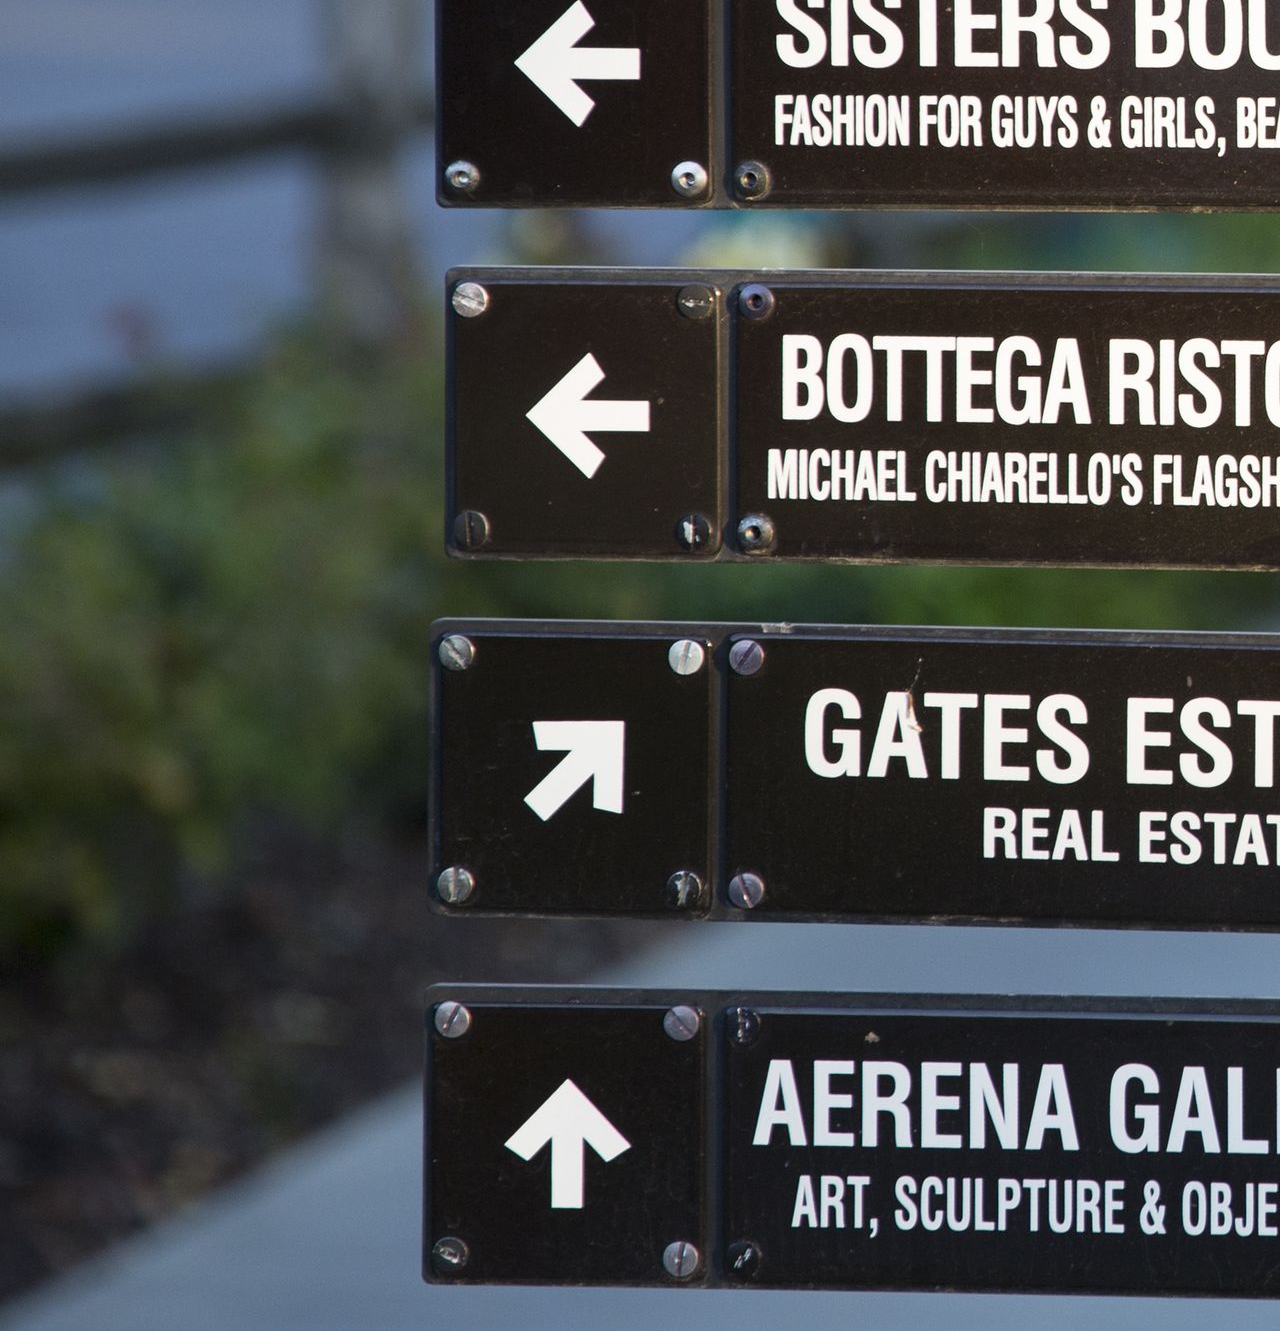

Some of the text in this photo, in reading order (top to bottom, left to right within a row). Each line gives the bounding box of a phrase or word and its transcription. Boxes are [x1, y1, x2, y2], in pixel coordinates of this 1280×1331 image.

[774, 93, 911, 148] FASHION
[918, 94, 984, 148] FOR
[990, 94, 1079, 149] GUYS
[1087, 95, 1113, 149] &
[1120, 95, 1227, 158] GIRLS,
[781, 332, 1092, 426] BOTTEGA
[767, 447, 917, 502] MICHAEL
[924, 449, 1144, 507] CHIARELLO'S
[804, 687, 1090, 785] GATES
[983, 806, 1120, 862] REAL
[752, 1059, 1080, 1151] AERENA
[791, 1174, 878, 1239] ART,
[894, 1175, 1125, 1234] SCULPTURE
[1139, 1179, 1167, 1235] &
